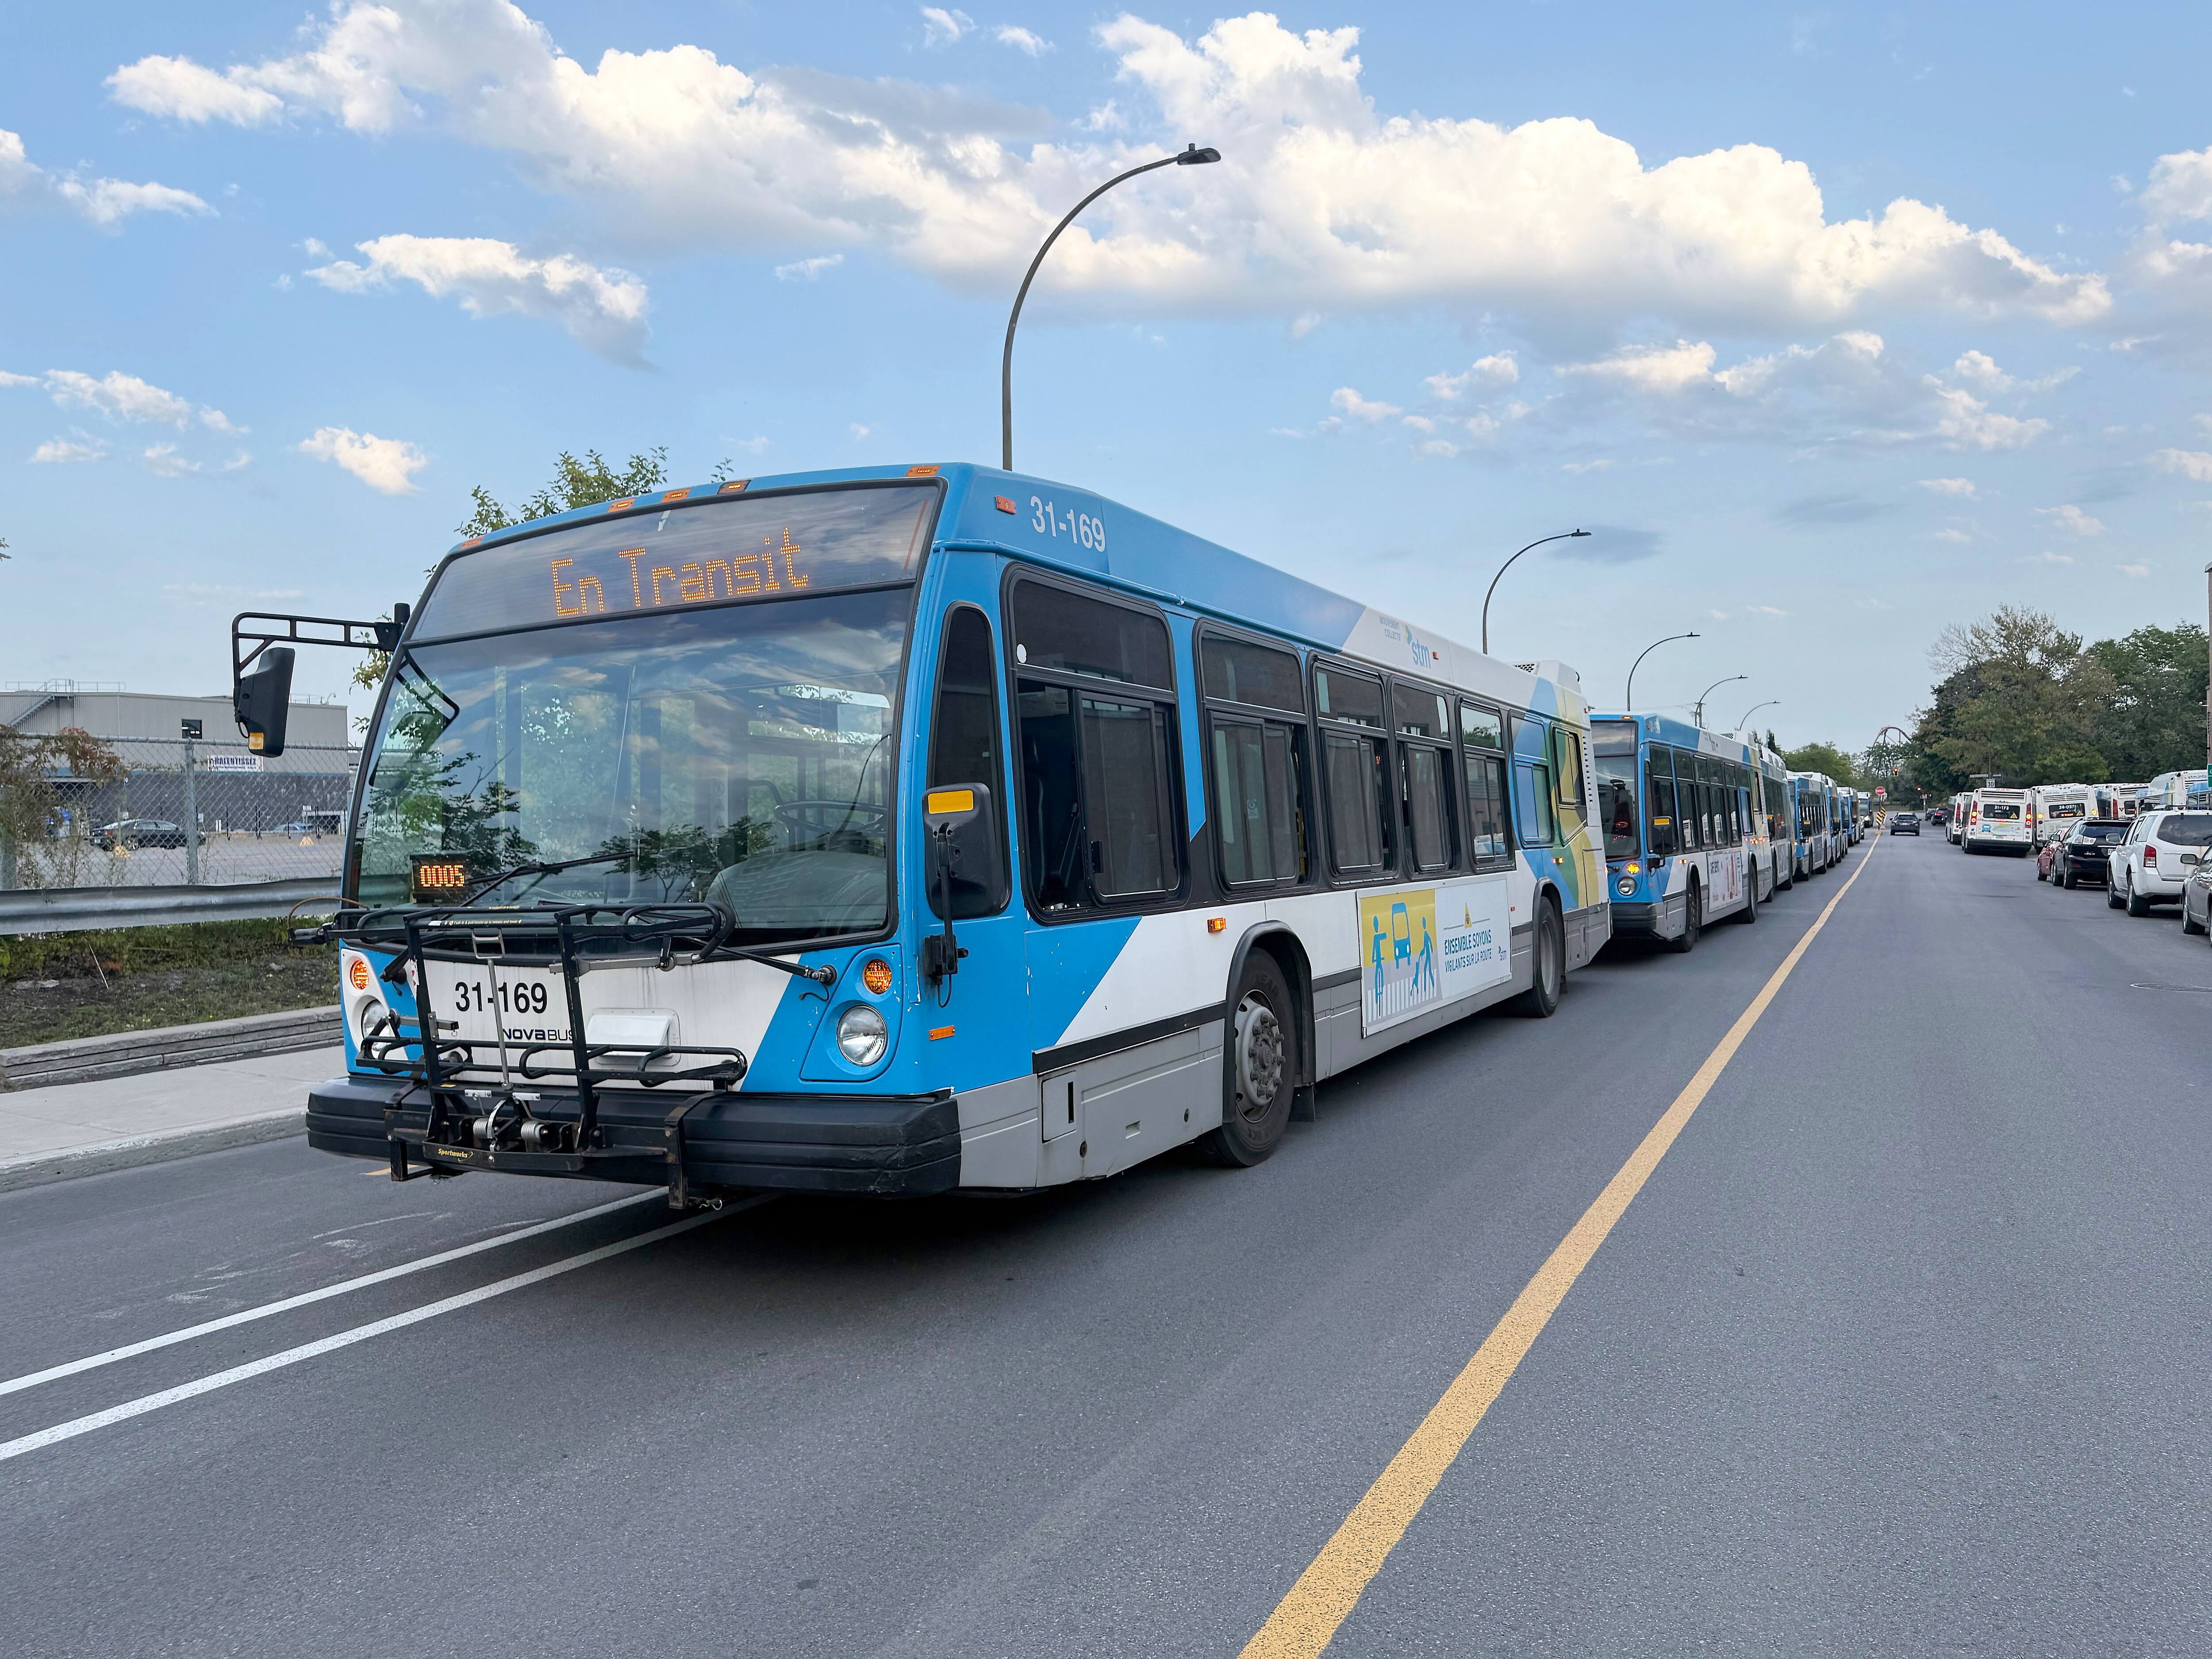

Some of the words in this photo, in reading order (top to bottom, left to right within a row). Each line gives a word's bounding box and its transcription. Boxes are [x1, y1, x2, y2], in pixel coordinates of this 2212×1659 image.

[1030, 496, 1106, 552] 31-169
[551, 558, 605, 617] En
[618, 526, 808, 607] Transit
[1412, 638, 1431, 669] stm
[420, 865, 465, 887] 0005
[1444, 934, 1472, 955] ENSEMBLE
[1473, 929, 1491, 948] SOYONS
[1445, 956, 1466, 972] VIGILANTS
[1475, 952, 1479, 964] LA
[1480, 948, 1491, 961] ROUTE
[455, 982, 547, 1014] 31-169
[438, 1148, 468, 1158] Sportworks
